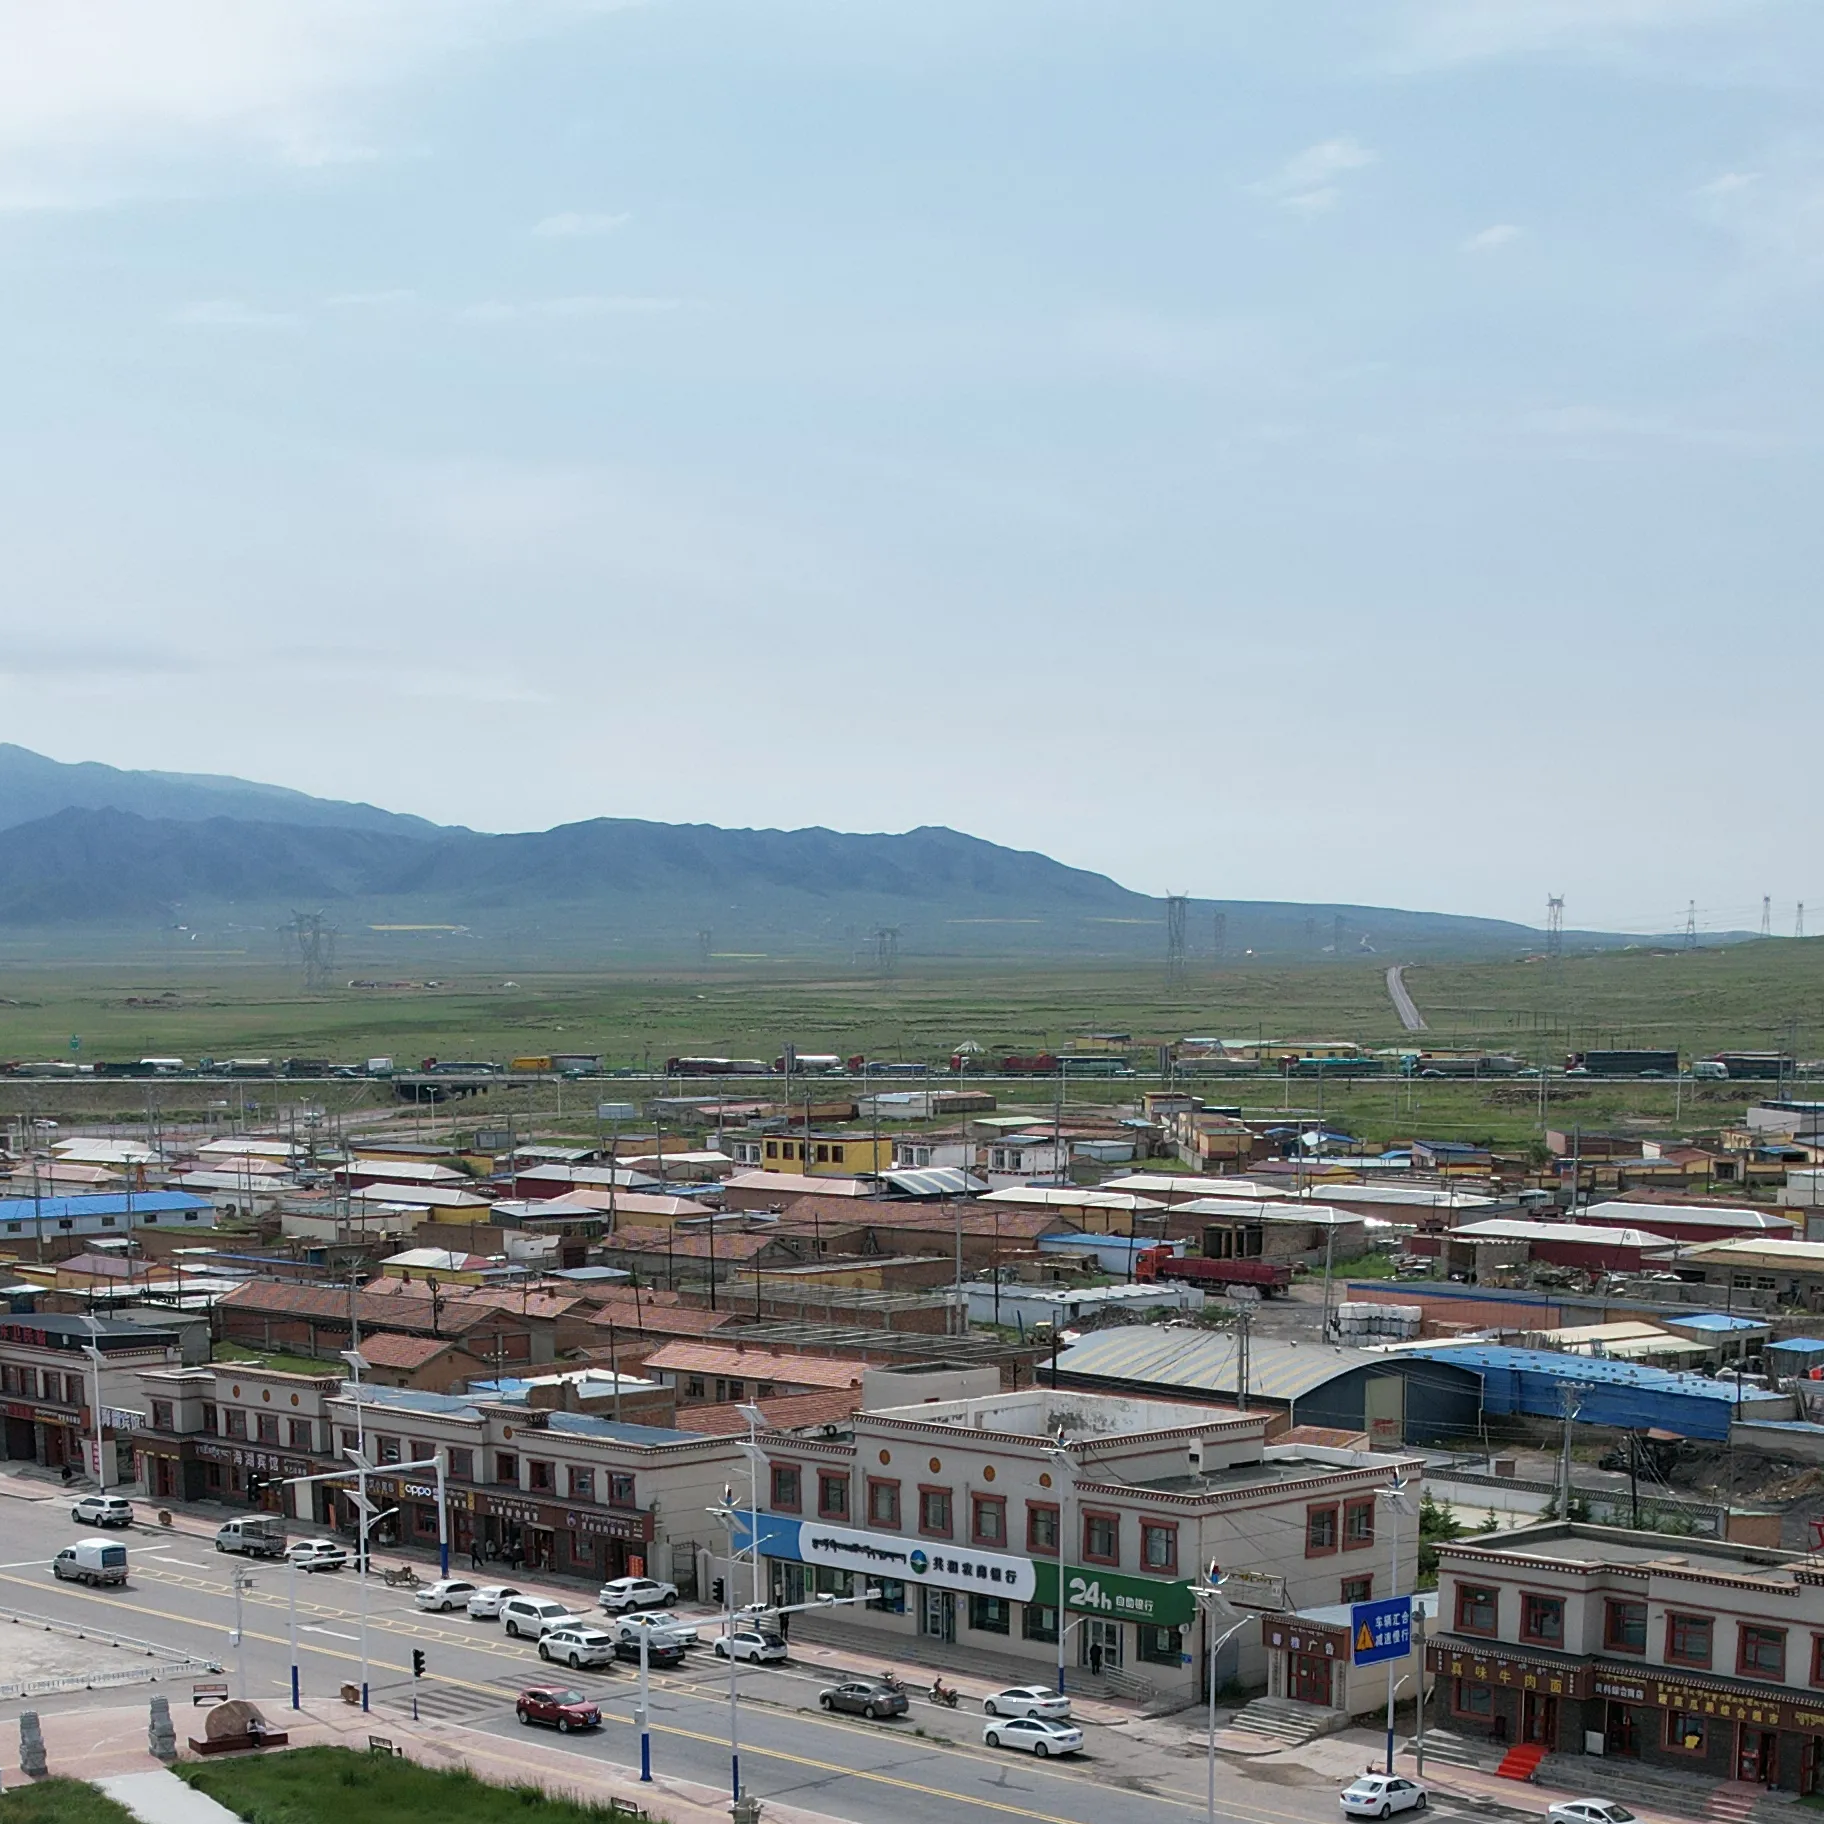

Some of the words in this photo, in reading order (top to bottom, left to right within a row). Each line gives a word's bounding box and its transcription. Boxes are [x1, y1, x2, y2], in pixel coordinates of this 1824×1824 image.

[933, 1556, 1018, 1585] 共和农商银行
[1069, 1577, 1113, 1611] 24h
[1375, 1612, 1409, 1628] 车辆汇合
[1375, 1629, 1409, 1647] 减速慢行
